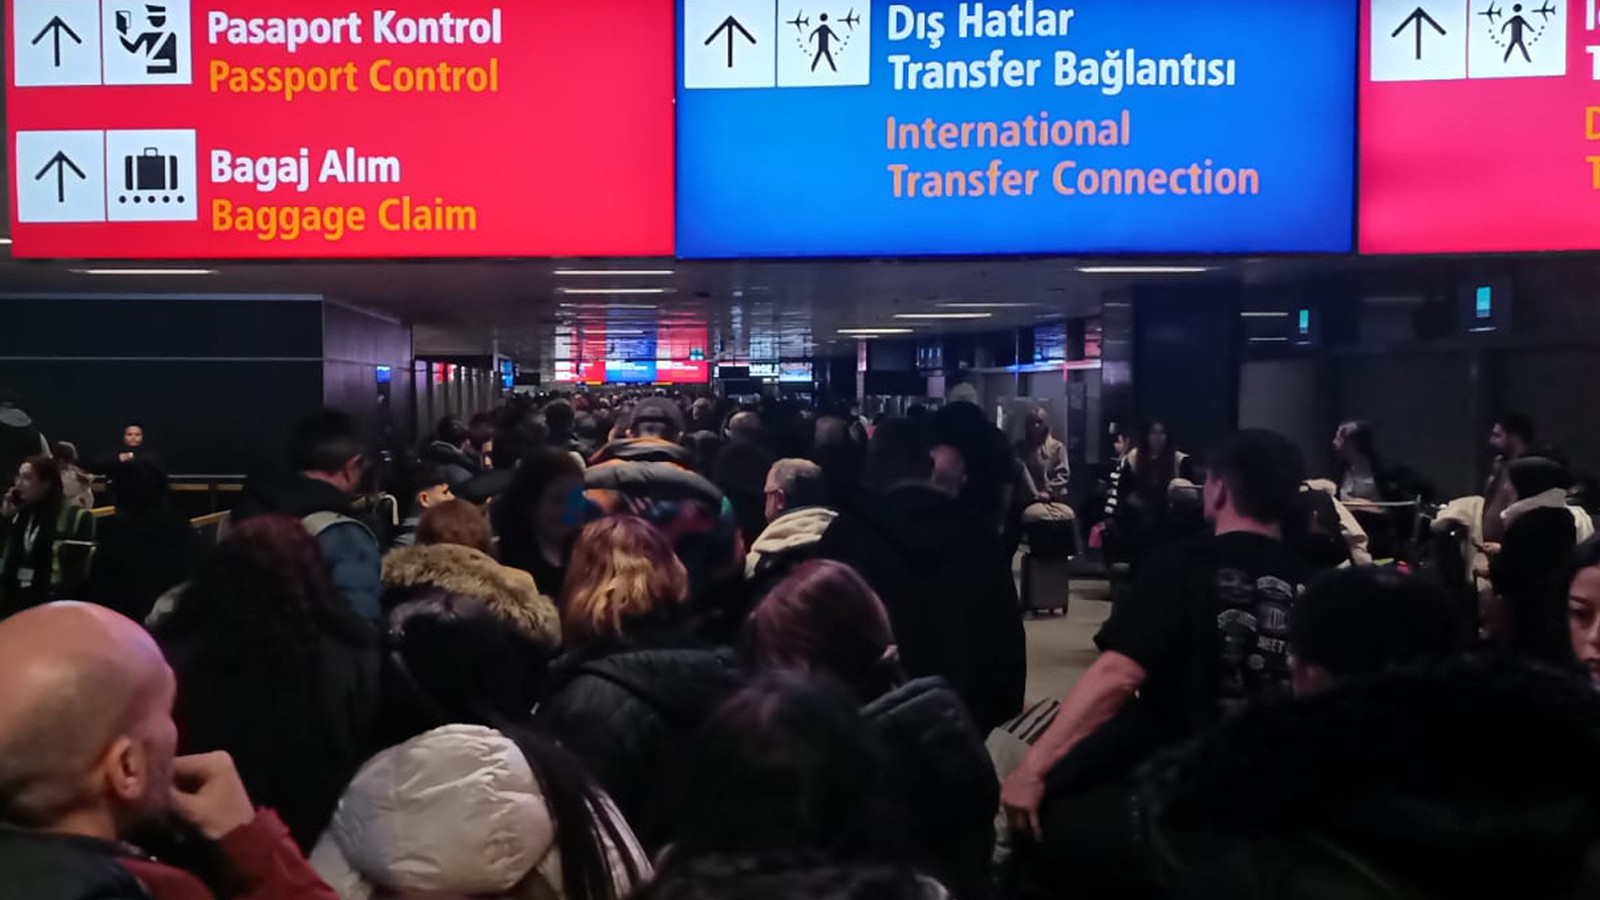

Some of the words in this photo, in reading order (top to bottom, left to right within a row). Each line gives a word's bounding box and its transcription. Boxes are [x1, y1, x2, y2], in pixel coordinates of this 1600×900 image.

[208, 11, 362, 52] Pasaport
[373, 9, 502, 44] Kontrol
[888, 4, 944, 48] Dış
[959, 0, 1074, 38] Hatlar
[210, 60, 358, 101] Passport
[370, 58, 498, 92] Control
[888, 50, 1041, 90] Transfer
[1054, 49, 1236, 95] Bağlantısı
[886, 110, 1130, 150] International
[210, 149, 309, 191] Bagaj
[319, 148, 401, 183] Alım
[888, 160, 1040, 198] Transfer
[1052, 160, 1260, 196] Connection
[211, 199, 366, 240] Baggage
[378, 196, 477, 231] Claim
